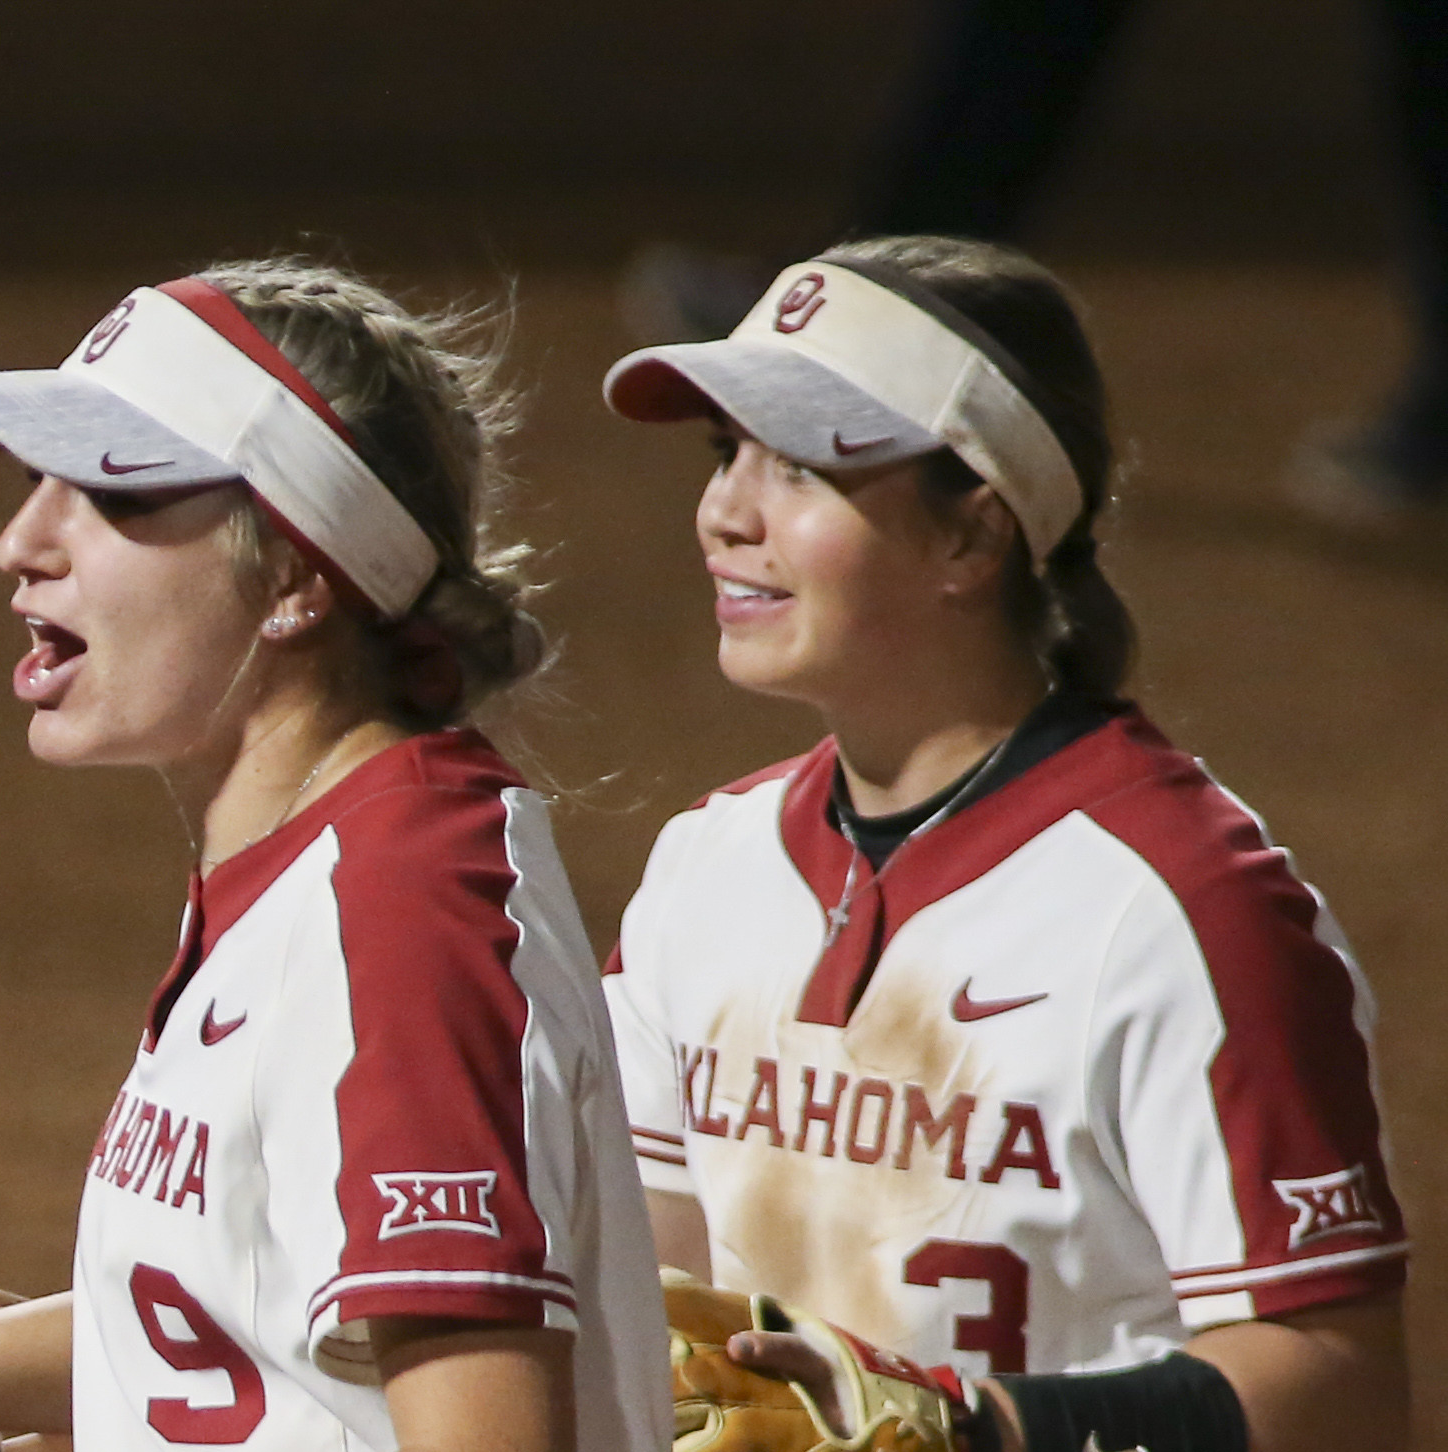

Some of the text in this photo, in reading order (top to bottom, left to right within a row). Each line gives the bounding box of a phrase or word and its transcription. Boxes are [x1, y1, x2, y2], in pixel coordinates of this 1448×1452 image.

[82, 298, 133, 364] OU
[774, 273, 827, 334] OU
[677, 1042, 1059, 1190] KLAHOMA
[372, 1171, 501, 1240] XII
[129, 1262, 266, 1445] 9
[903, 1238, 1030, 1374] 3
